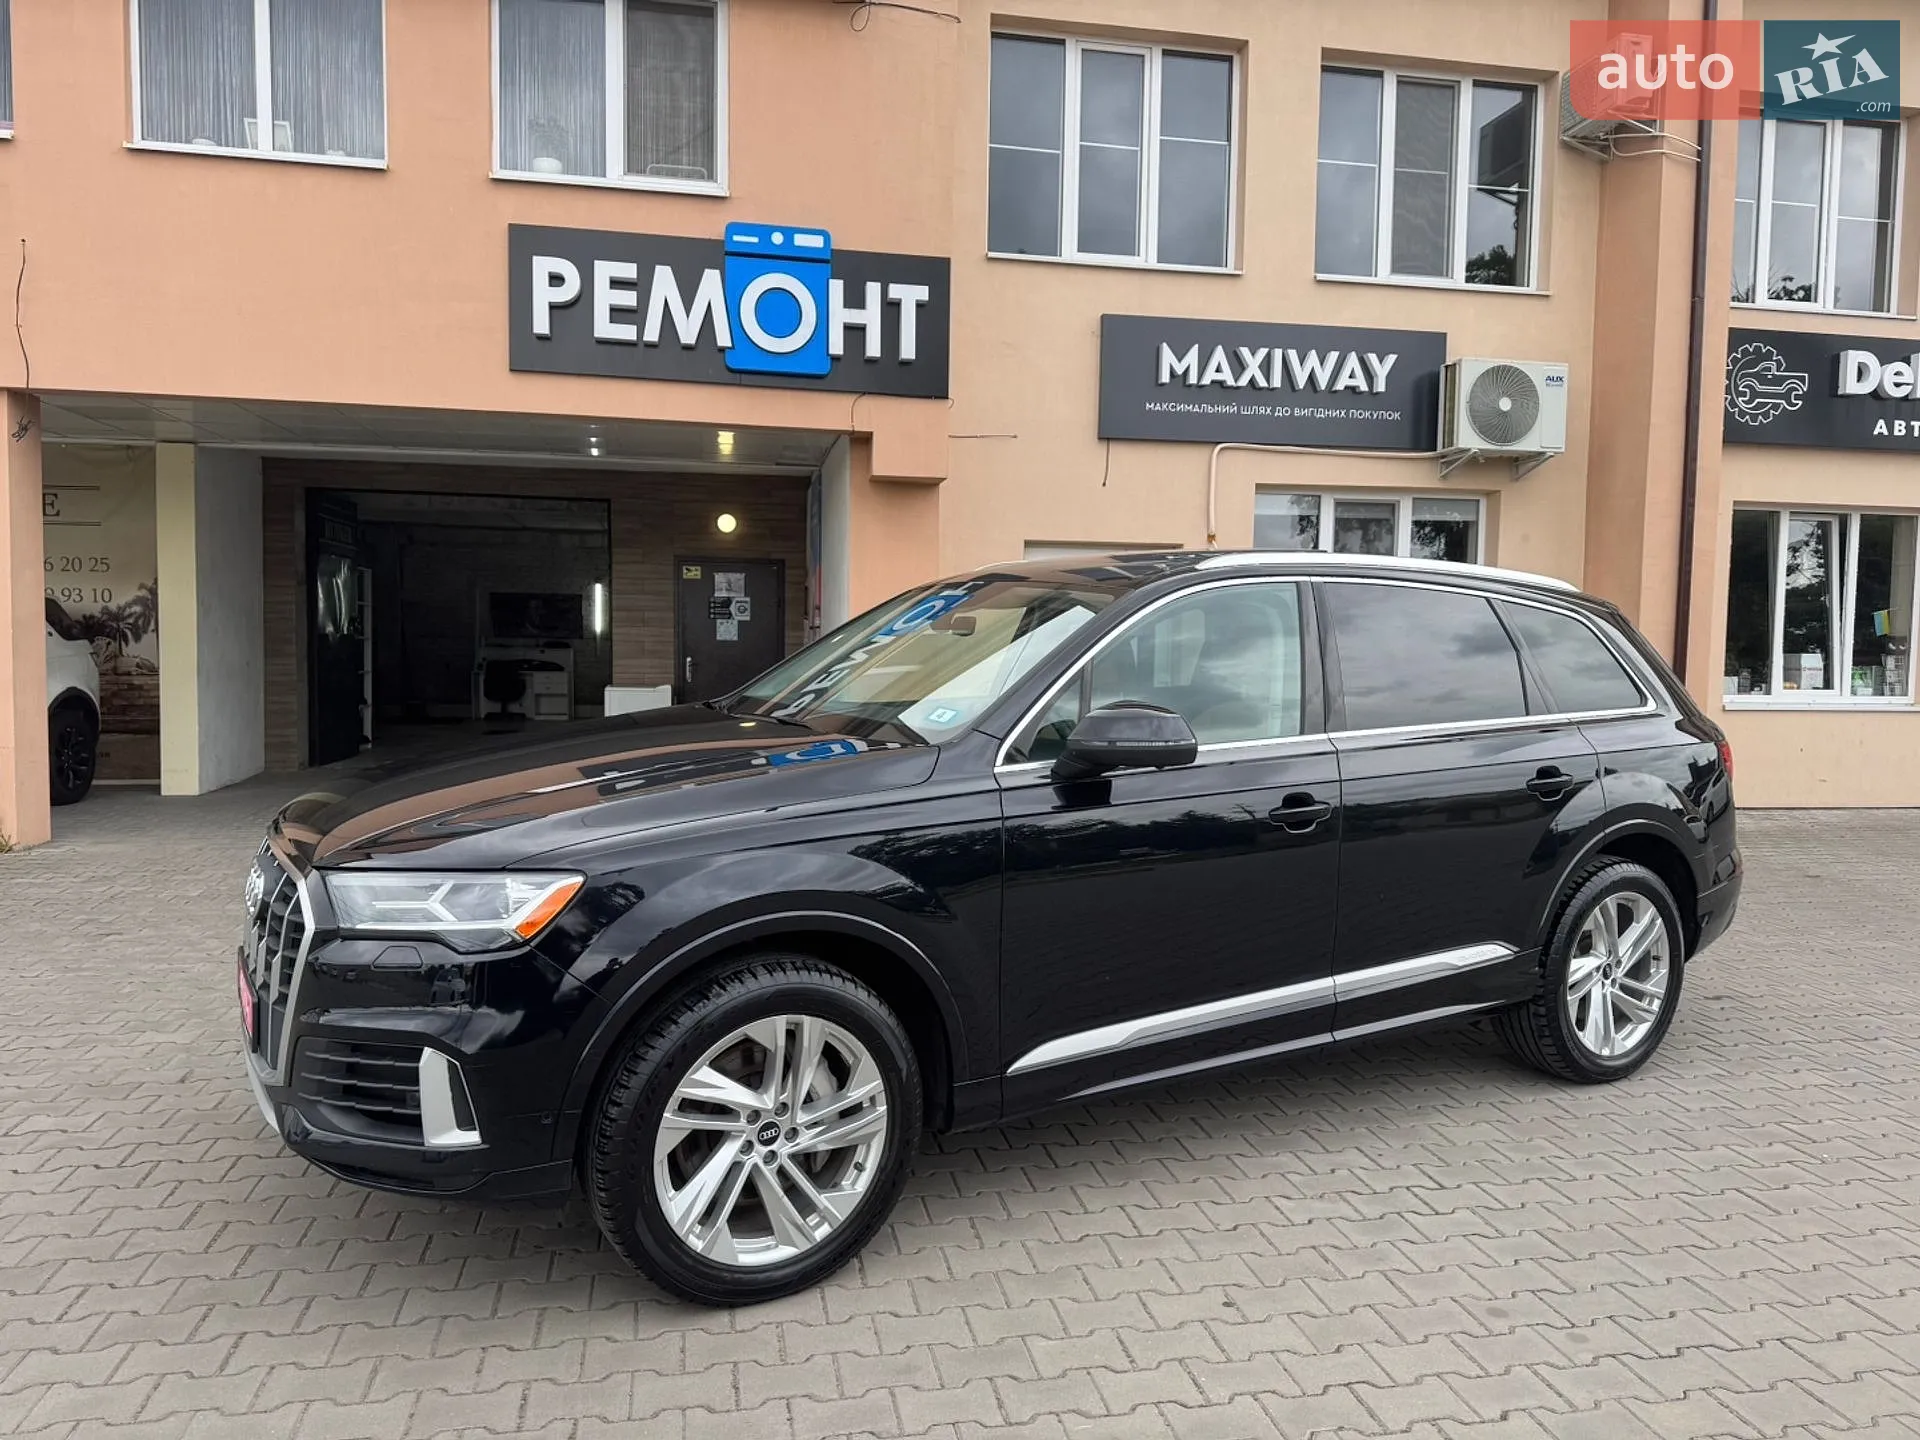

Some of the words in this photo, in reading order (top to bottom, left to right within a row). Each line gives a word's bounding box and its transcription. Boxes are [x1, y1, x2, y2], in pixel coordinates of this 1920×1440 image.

[531, 254, 930, 364] РЕМОНТ
[1157, 342, 1399, 393] MAXIWAY
[1145, 402, 1237, 414] МАКСИМАЛЬНИЙ
[1240, 405, 1272, 415] ШЛЯХ
[1275, 406, 1291, 417] ДО
[1294, 407, 1347, 419] ВИГІДНИХ
[1349, 409, 1401, 421] ПОКУПОК
[60, 556, 82, 573] 20
[88, 557, 111, 573] 25
[60, 587, 83, 603] 93
[92, 587, 112, 603] 10
